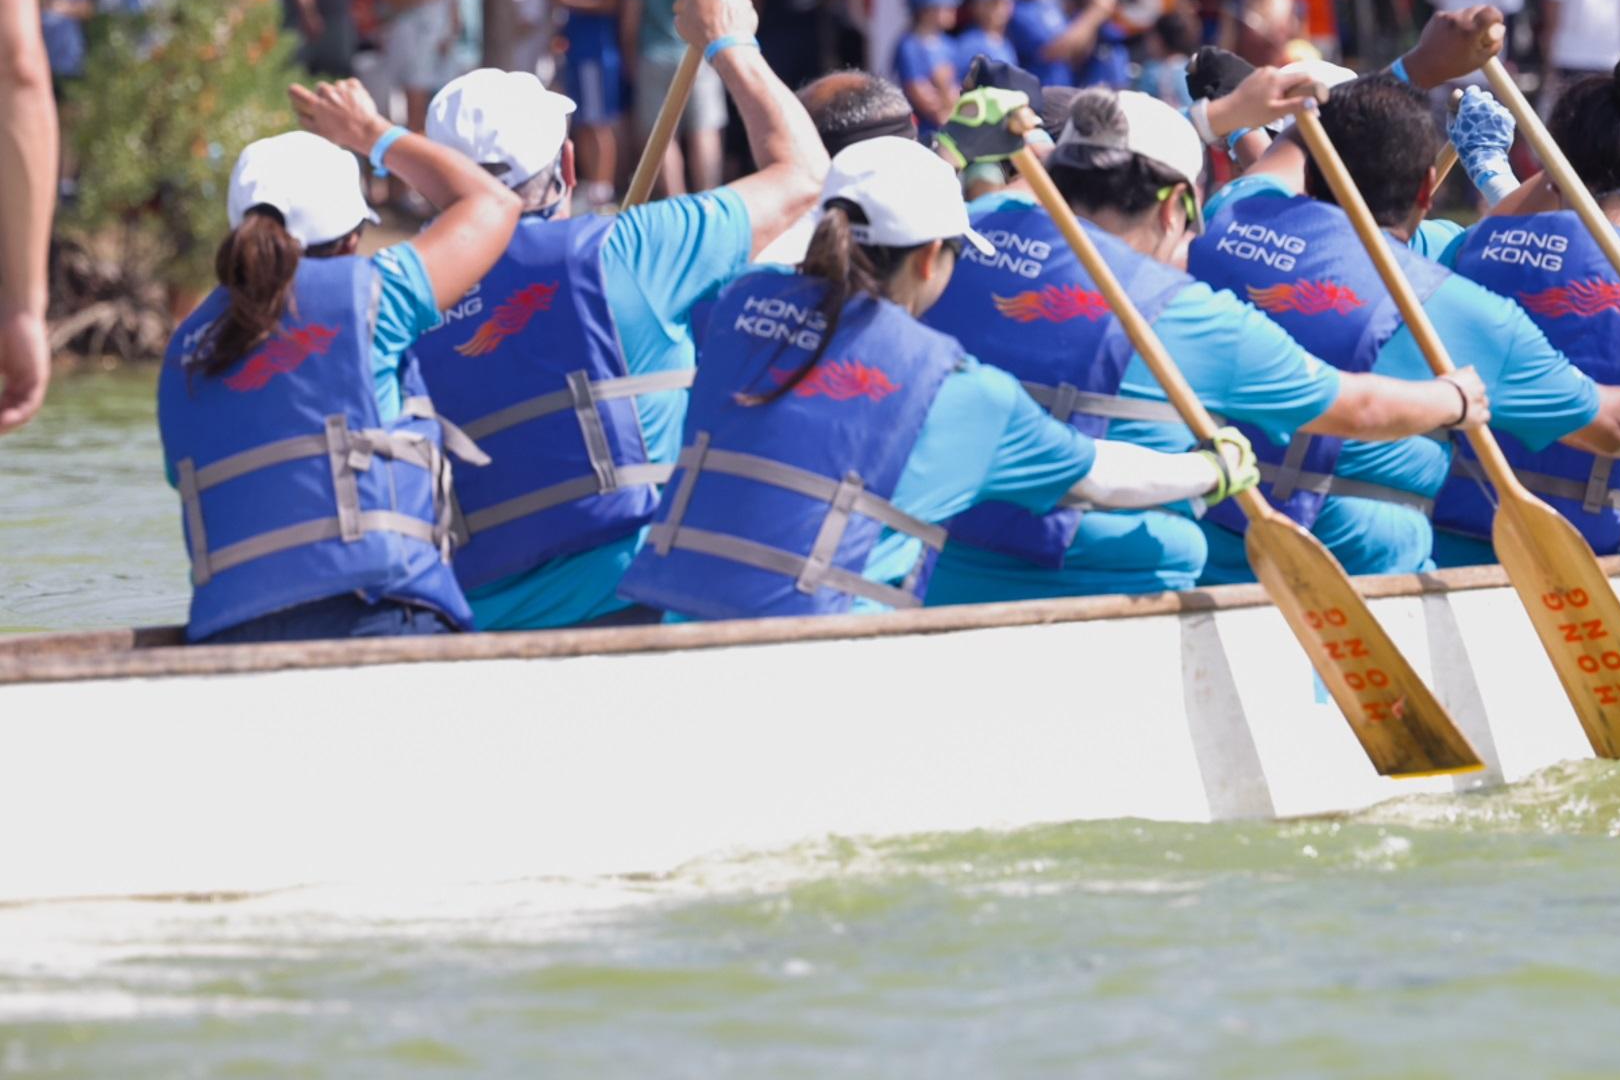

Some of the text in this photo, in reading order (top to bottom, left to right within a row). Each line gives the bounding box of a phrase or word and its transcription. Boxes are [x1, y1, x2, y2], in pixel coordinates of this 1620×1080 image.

[976, 228, 1053, 261] ONG
[1216, 236, 1297, 273] KONG
[1226, 220, 1307, 256] HONG
[1488, 229, 1569, 253] HONG
[961, 244, 1043, 280] KONG
[1481, 245, 1563, 272] KONG
[734, 313, 821, 351] KONG
[743, 296, 828, 332] HONG
[1541, 591, 1619, 705] HONG
